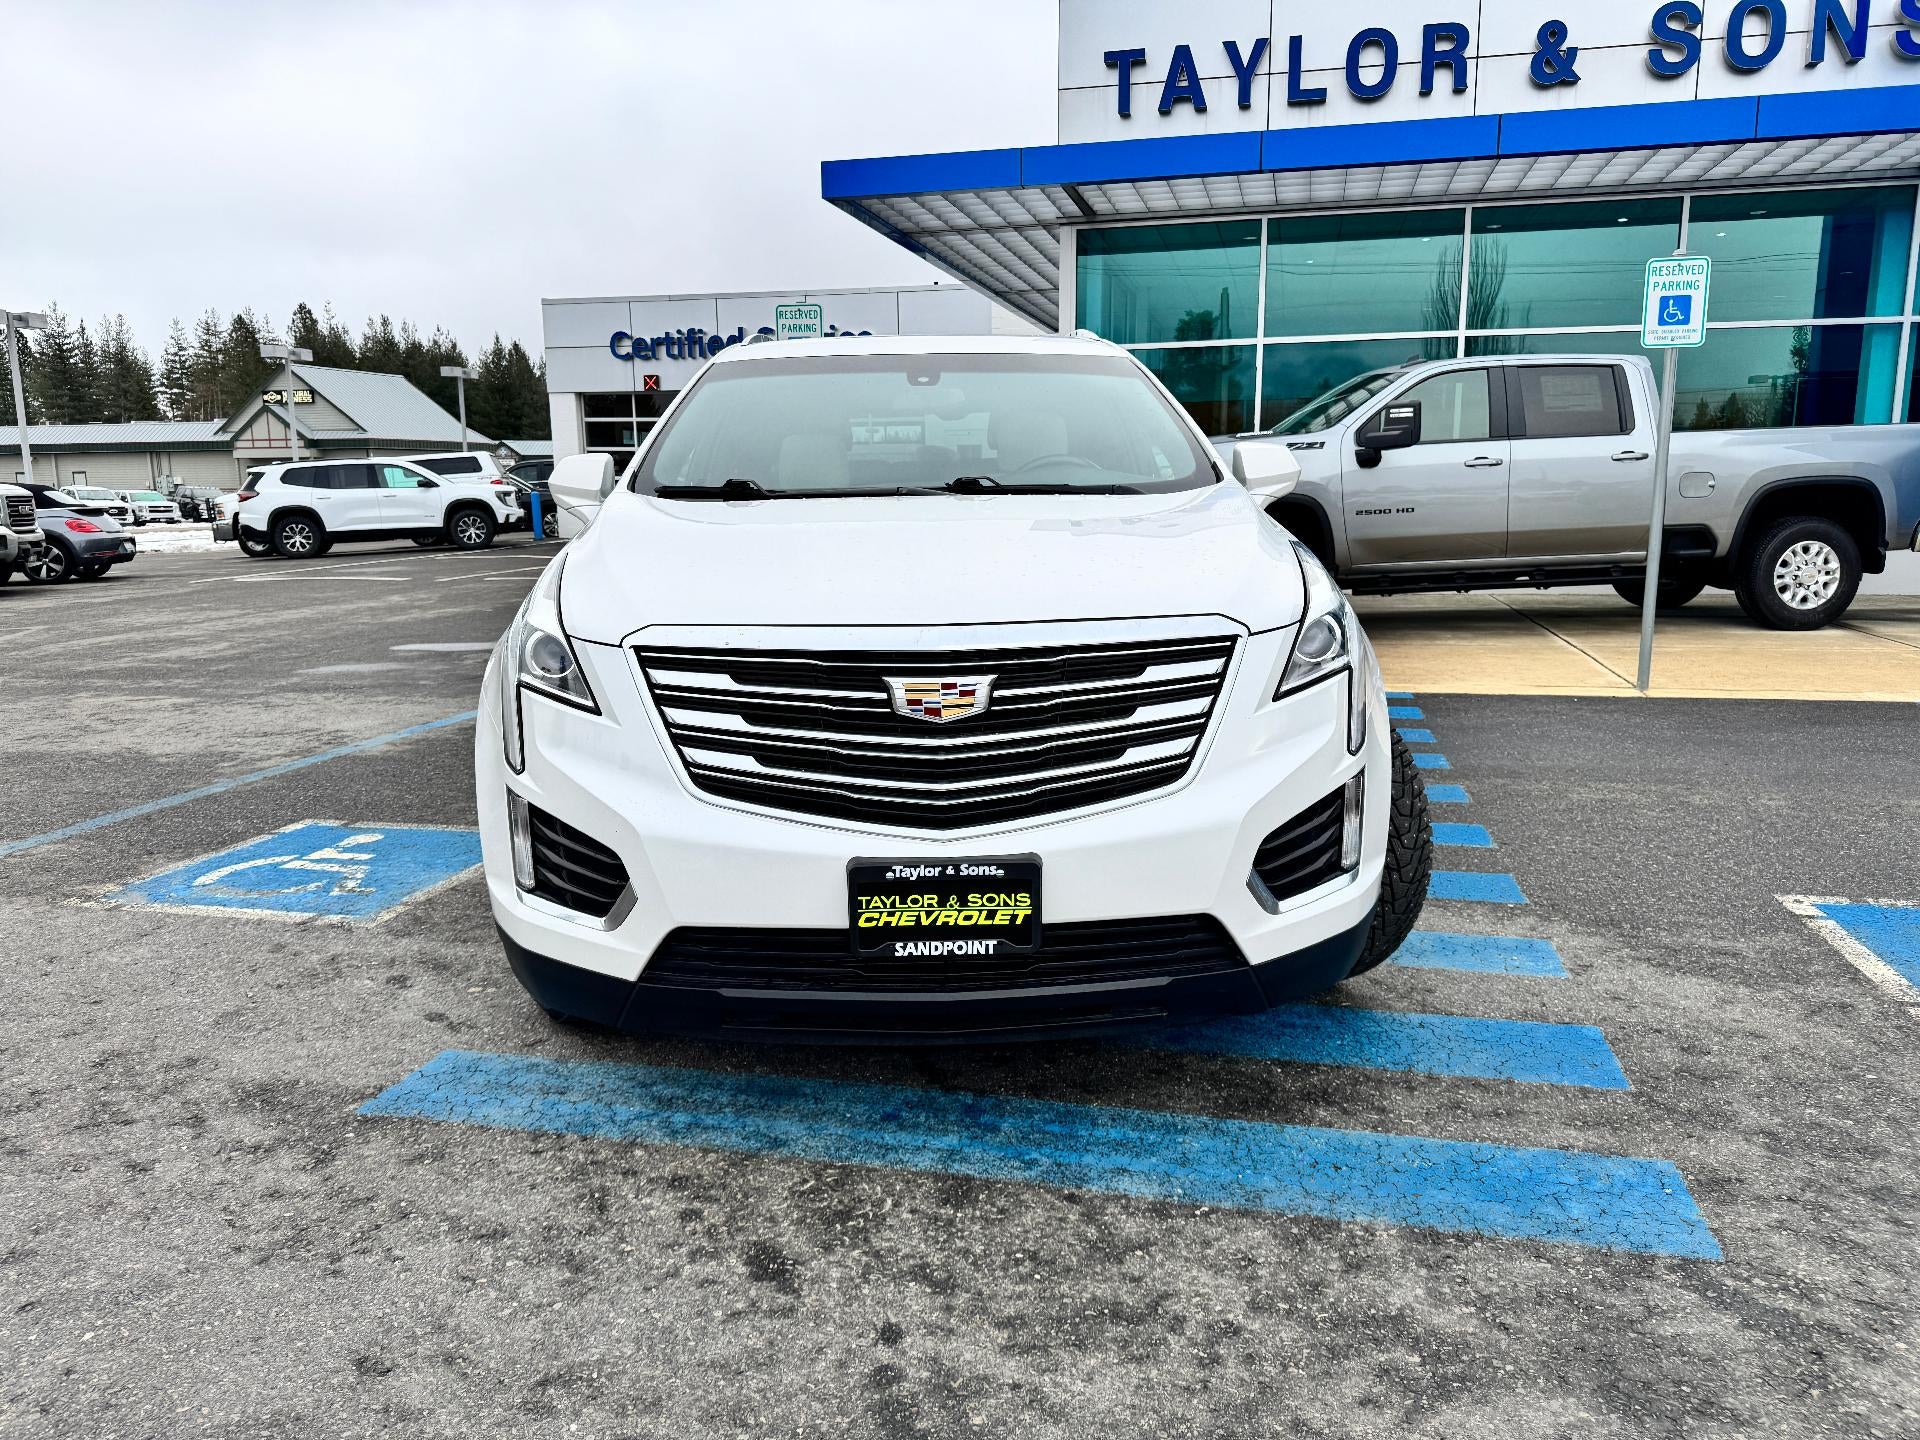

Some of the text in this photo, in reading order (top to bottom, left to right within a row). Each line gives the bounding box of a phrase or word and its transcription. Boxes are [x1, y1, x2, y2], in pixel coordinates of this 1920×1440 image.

[1104, 22, 1471, 117] TAYLOR
[1528, 20, 1580, 87] &
[1651, 264, 1705, 277] RESERVED
[1653, 280, 1700, 292] PARKING
[778, 309, 819, 320] RESERVED
[781, 323, 817, 333] PARKING
[609, 327, 744, 360] Certified
[1355, 508, 1392, 516] 2500
[892, 864, 997, 880] Taylor & Sons
[858, 893, 1031, 909] TAYLOR & SONS
[858, 910, 1032, 928] CHEVROLET
[894, 940, 998, 956] SANDPOINT
